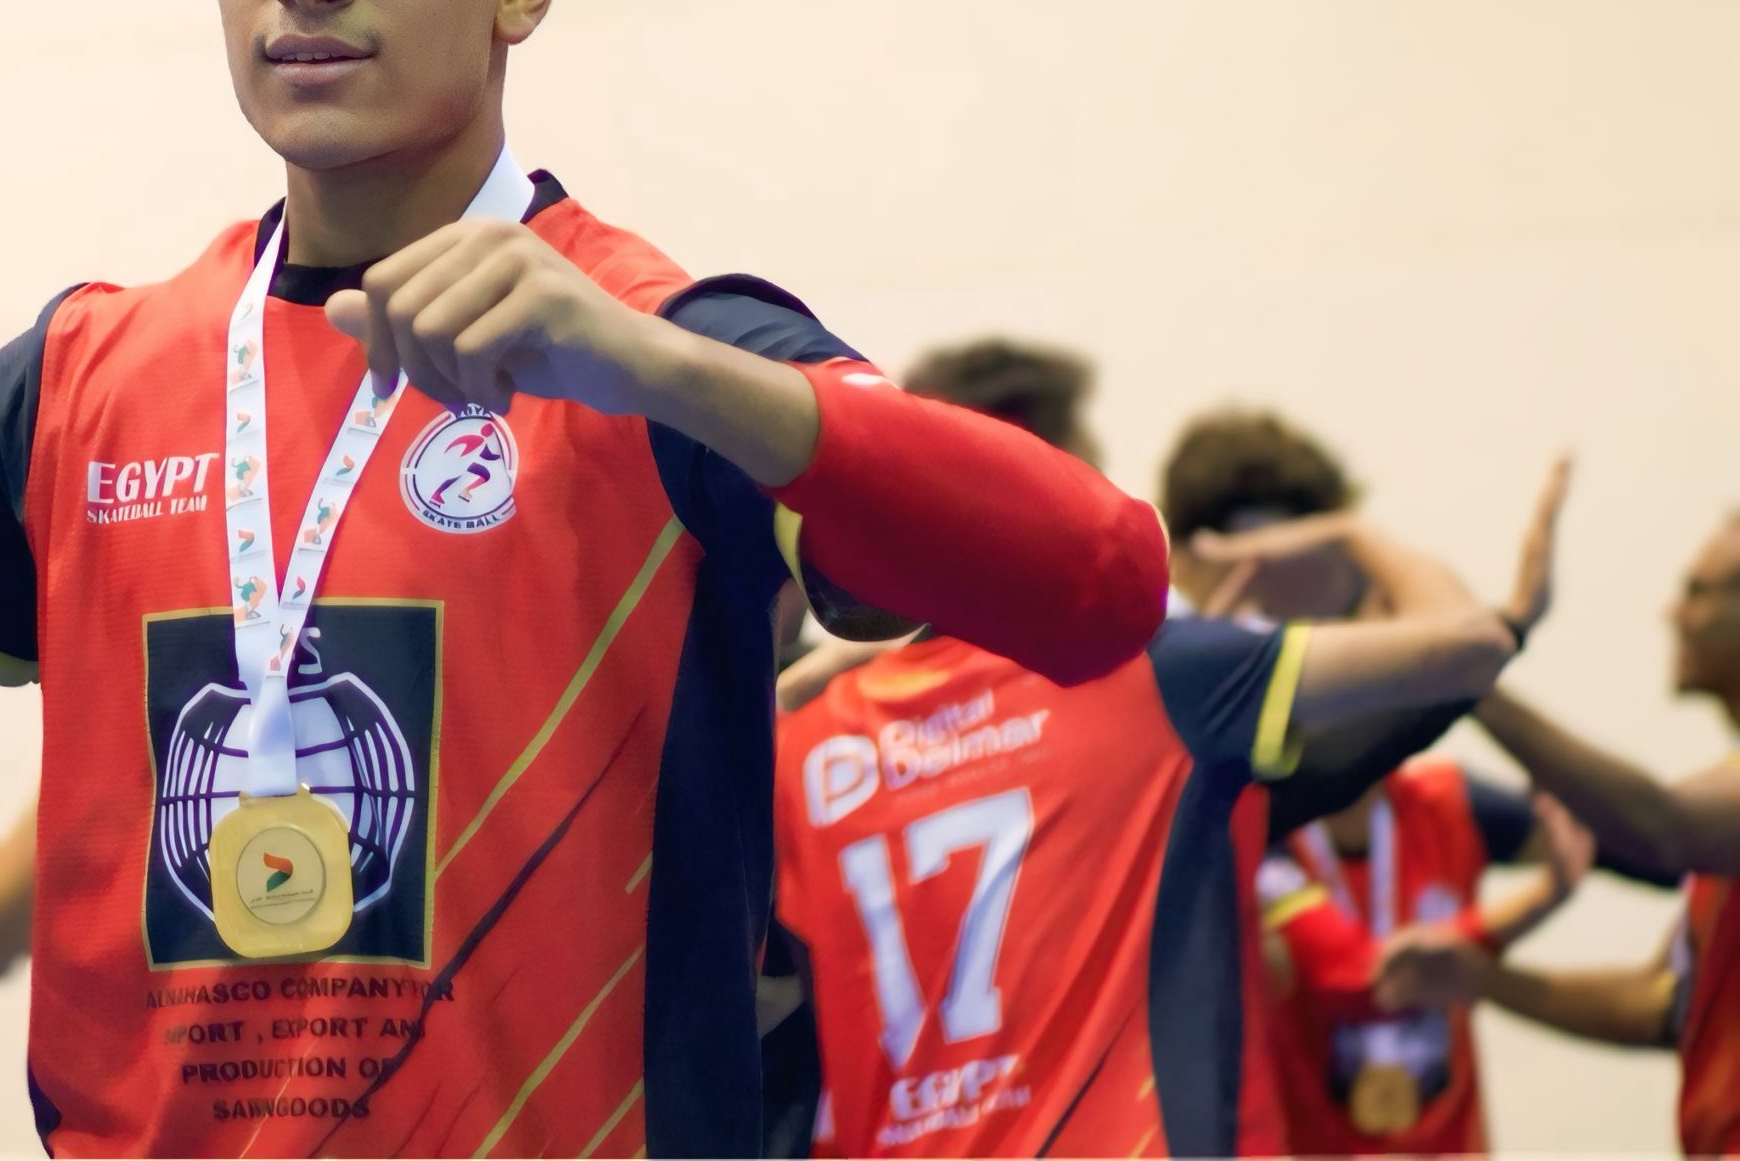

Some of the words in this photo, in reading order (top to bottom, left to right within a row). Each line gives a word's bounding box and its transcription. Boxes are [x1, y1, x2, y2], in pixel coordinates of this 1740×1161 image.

[87, 453, 220, 504] EGYPT
[87, 501, 163, 525] SKATEBALL
[170, 495, 207, 515] TEAM
[466, 514, 500, 529] BALL
[837, 786, 1035, 1071] 17
[280, 977, 406, 1000] COMPANY
[272, 1017, 369, 1040] EXPORT
[181, 1056, 347, 1085] PRODUCTION
